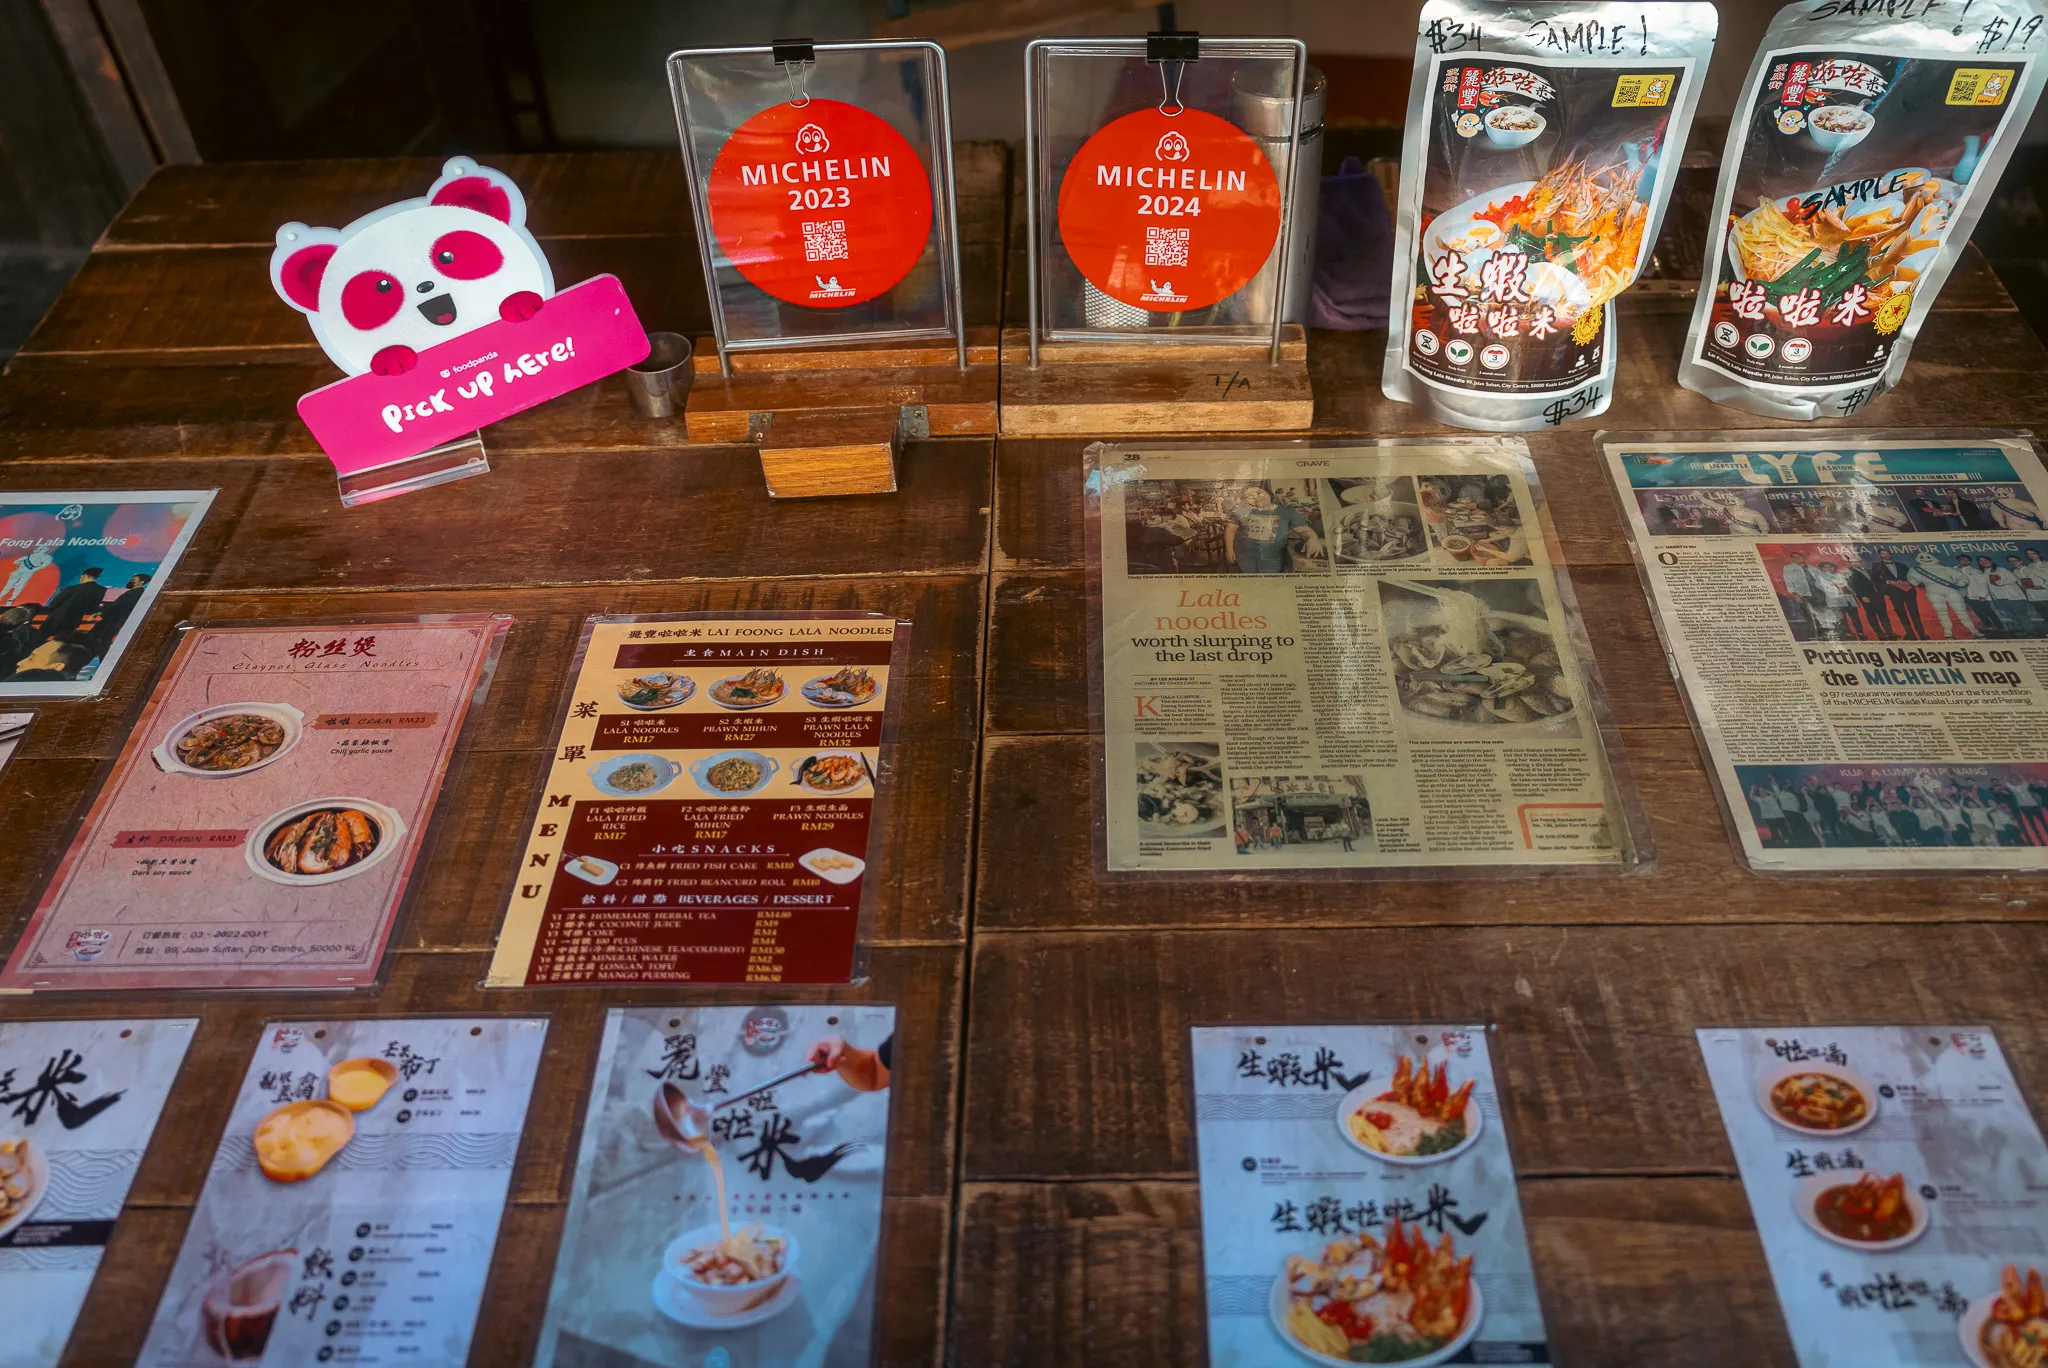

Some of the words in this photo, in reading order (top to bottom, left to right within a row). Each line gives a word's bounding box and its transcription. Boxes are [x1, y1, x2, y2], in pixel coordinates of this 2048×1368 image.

[1425, 16, 1481, 54] $34
[1976, 15, 2044, 54] $19
[1460, 69, 1479, 106] 麗豐
[1784, 64, 1808, 102] 麗豐
[742, 155, 891, 186] MICHELIN
[1097, 166, 1246, 191] MICHELIN
[789, 186, 851, 211] 2023
[1802, 173, 1908, 221] SAMPLE
[1138, 195, 1201, 217] 2024
[1432, 251, 1531, 303] 生蝦
[809, 288, 856, 299] MICHELIN
[1140, 293, 1188, 303] MICHELIN
[1729, 279, 1871, 328] 啦啦米
[1448, 304, 1558, 341] 啦啦米
[452, 351, 498, 374] foodpanda
[1445, 375, 1465, 383] Noodle
[1743, 368, 1763, 377] Noodle
[1543, 386, 1603, 426] $34
[0, 537, 33, 550] Fong
[36, 537, 65, 547] Lala
[68, 536, 127, 546] Noodles
[1951, 542, 2019, 552] PENANG
[1177, 589, 1241, 608] Lala
[1155, 612, 1268, 630] noodles
[735, 628, 784, 636] FOONG
[790, 628, 822, 636] LALA
[828, 627, 893, 635] NOODLES
[1131, 635, 1188, 648] worth
[1193, 634, 1272, 650] slurping
[1277, 636, 1295, 646] to
[684, 648, 715, 657] 主食
[719, 649, 770, 657] MAIN
[1155, 650, 1185, 662] the
[1191, 650, 1223, 662] last
[1227, 649, 1273, 664] drop
[1803, 649, 1884, 667] Putting
[1886, 648, 1986, 667] Malaysia
[1989, 650, 2019, 663] on
[233, 662, 291, 672] Claypot
[360, 660, 420, 668] Noodles
[1820, 670, 1859, 686] the
[1862, 668, 1967, 685] MICHELIN
[1971, 671, 2021, 688] map
[603, 727, 628, 735] LALA
[632, 726, 680, 734] NOODLES
[623, 735, 655, 743] RM17
[819, 739, 851, 747] RM32
[684, 813, 709, 821] LALA
[815, 812, 864, 820] NOODLES
[602, 822, 627, 830] RICE
[694, 821, 731, 829] MIHUN
[801, 822, 835, 831] RM29
[209, 834, 237, 842] RM31
[594, 832, 627, 840] RM17
[695, 830, 728, 839] RM17
[522, 794, 572, 899] MENU
[652, 844, 685, 854] 小吃
[691, 844, 776, 853] SNACKS
[704, 862, 728, 870] FISH
[766, 862, 795, 870] RM10
[700, 878, 757, 886] BEANCURD
[760, 878, 786, 886] ROLL
[792, 878, 820, 886] RM10
[678, 894, 759, 904] BEVERAGES
[773, 894, 834, 904] DESSERT
[1236, 1047, 1372, 1091] 生蝦米
